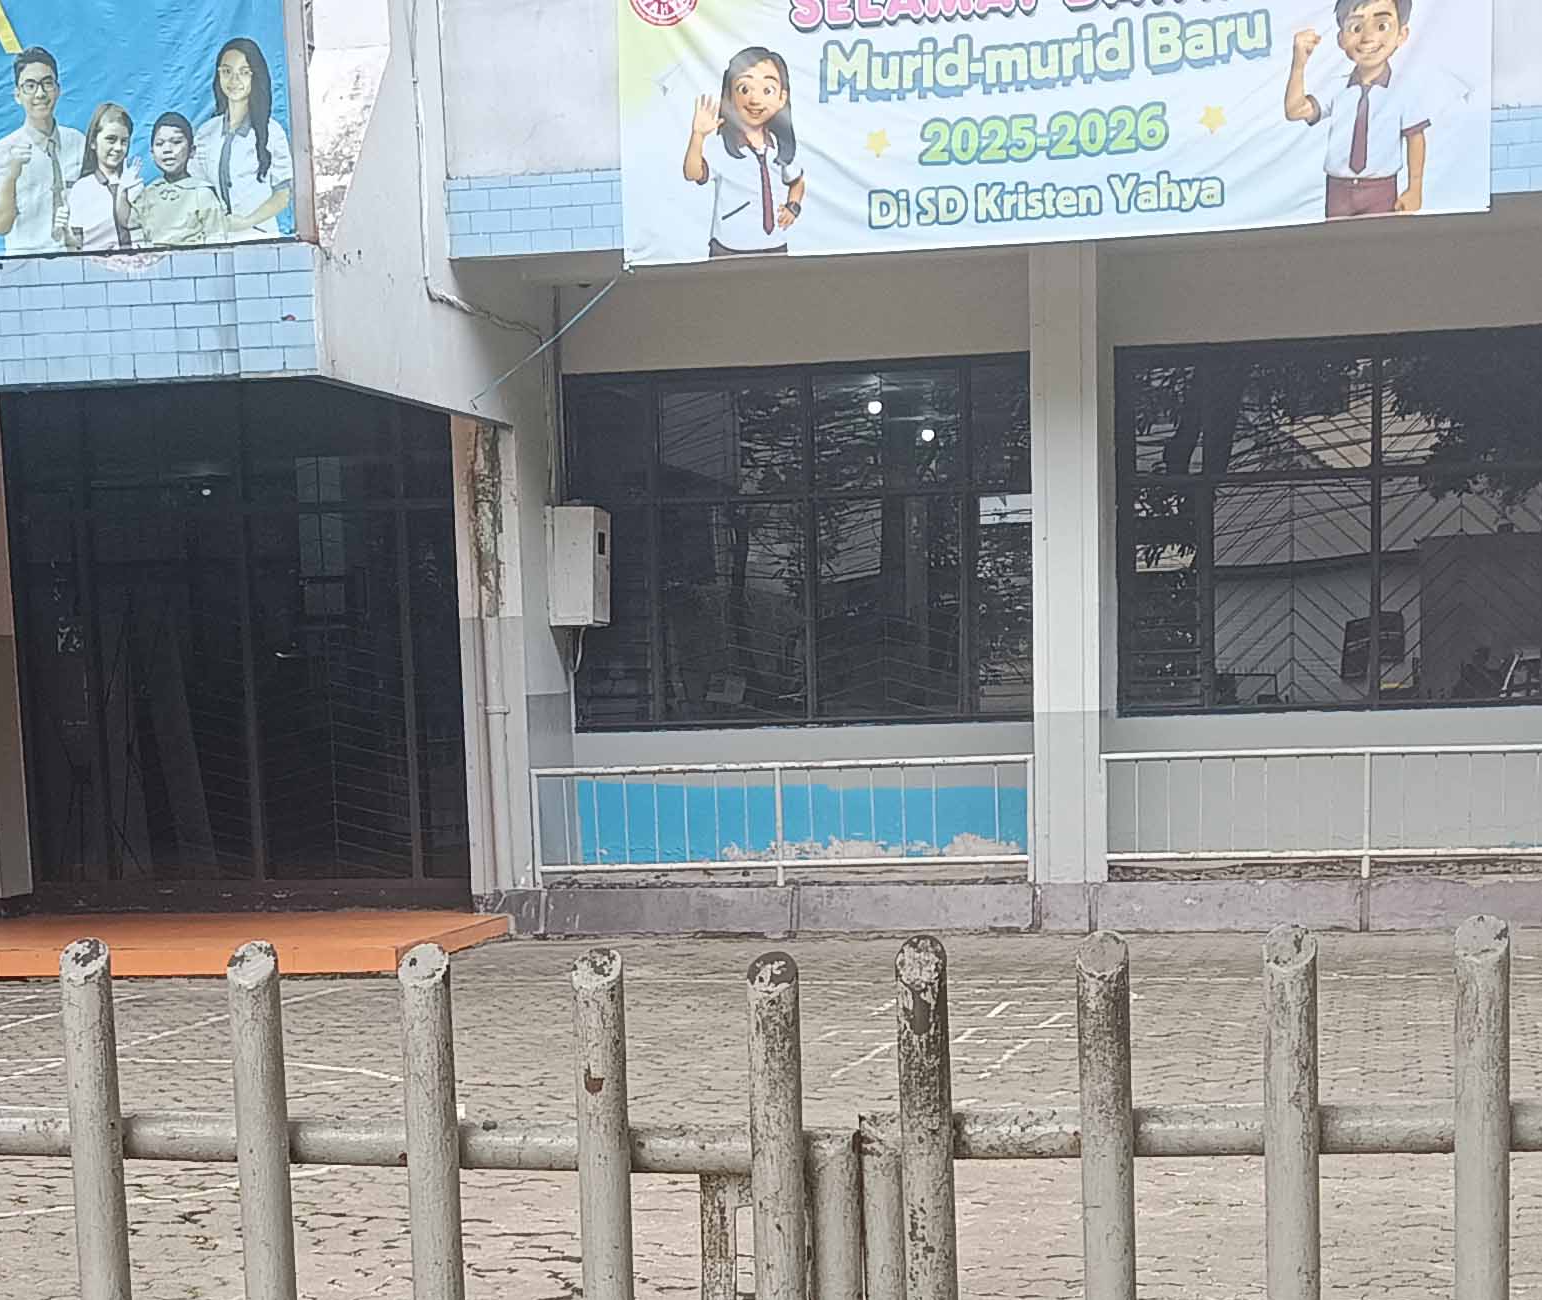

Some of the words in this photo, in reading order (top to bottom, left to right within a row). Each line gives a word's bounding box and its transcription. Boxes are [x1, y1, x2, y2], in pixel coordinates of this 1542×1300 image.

[819, 17, 1134, 103] Murid-murid
[1143, 9, 1271, 75] Baru
[918, 102, 1170, 166] 2025-2026
[869, 189, 910, 229] Di
[917, 186, 969, 226] SD
[974, 182, 1103, 223] Kristen
[1108, 171, 1225, 214] Yahya
